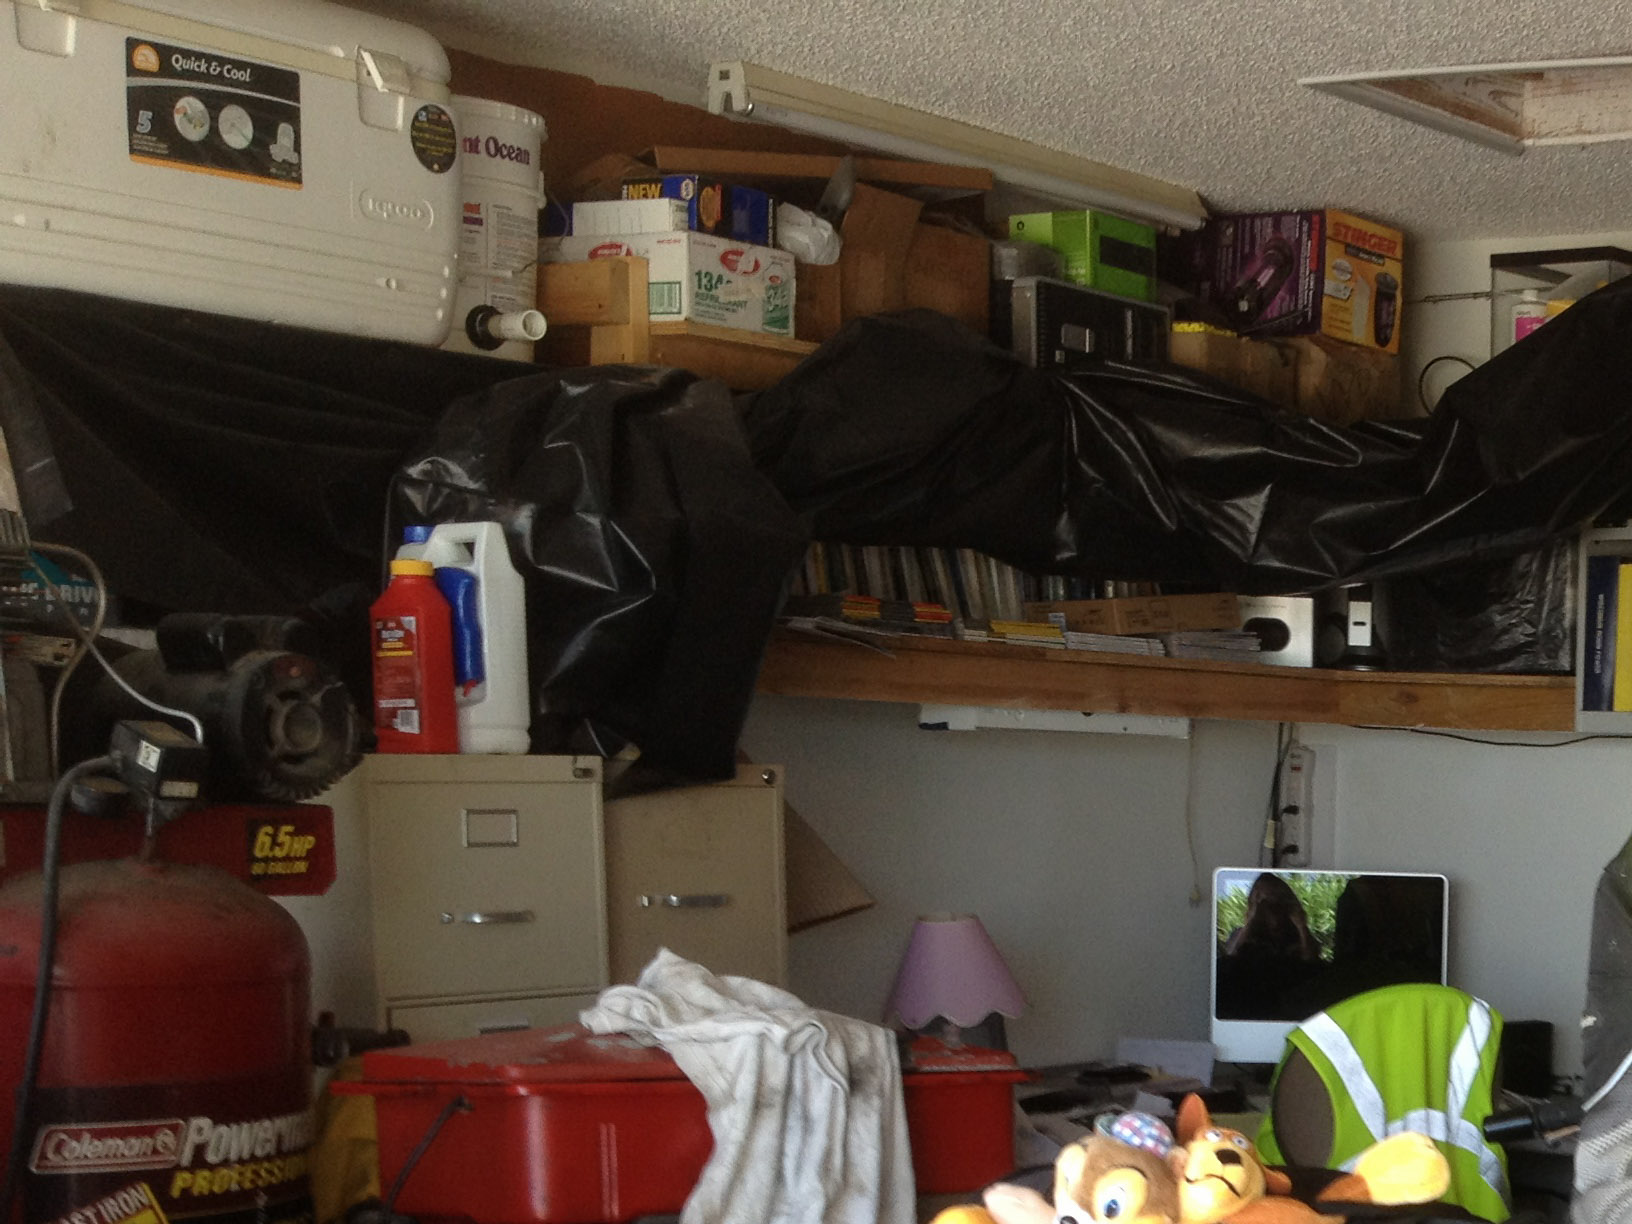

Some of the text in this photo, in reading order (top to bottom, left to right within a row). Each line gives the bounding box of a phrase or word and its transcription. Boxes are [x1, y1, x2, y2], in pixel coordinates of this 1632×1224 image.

[171, 54, 251, 82] Quick & Cool
[485, 136, 530, 165] Ocean
[628, 184, 662, 199] NEW
[1332, 222, 1398, 256] STINGER
[99, 1186, 148, 1224] IRON
